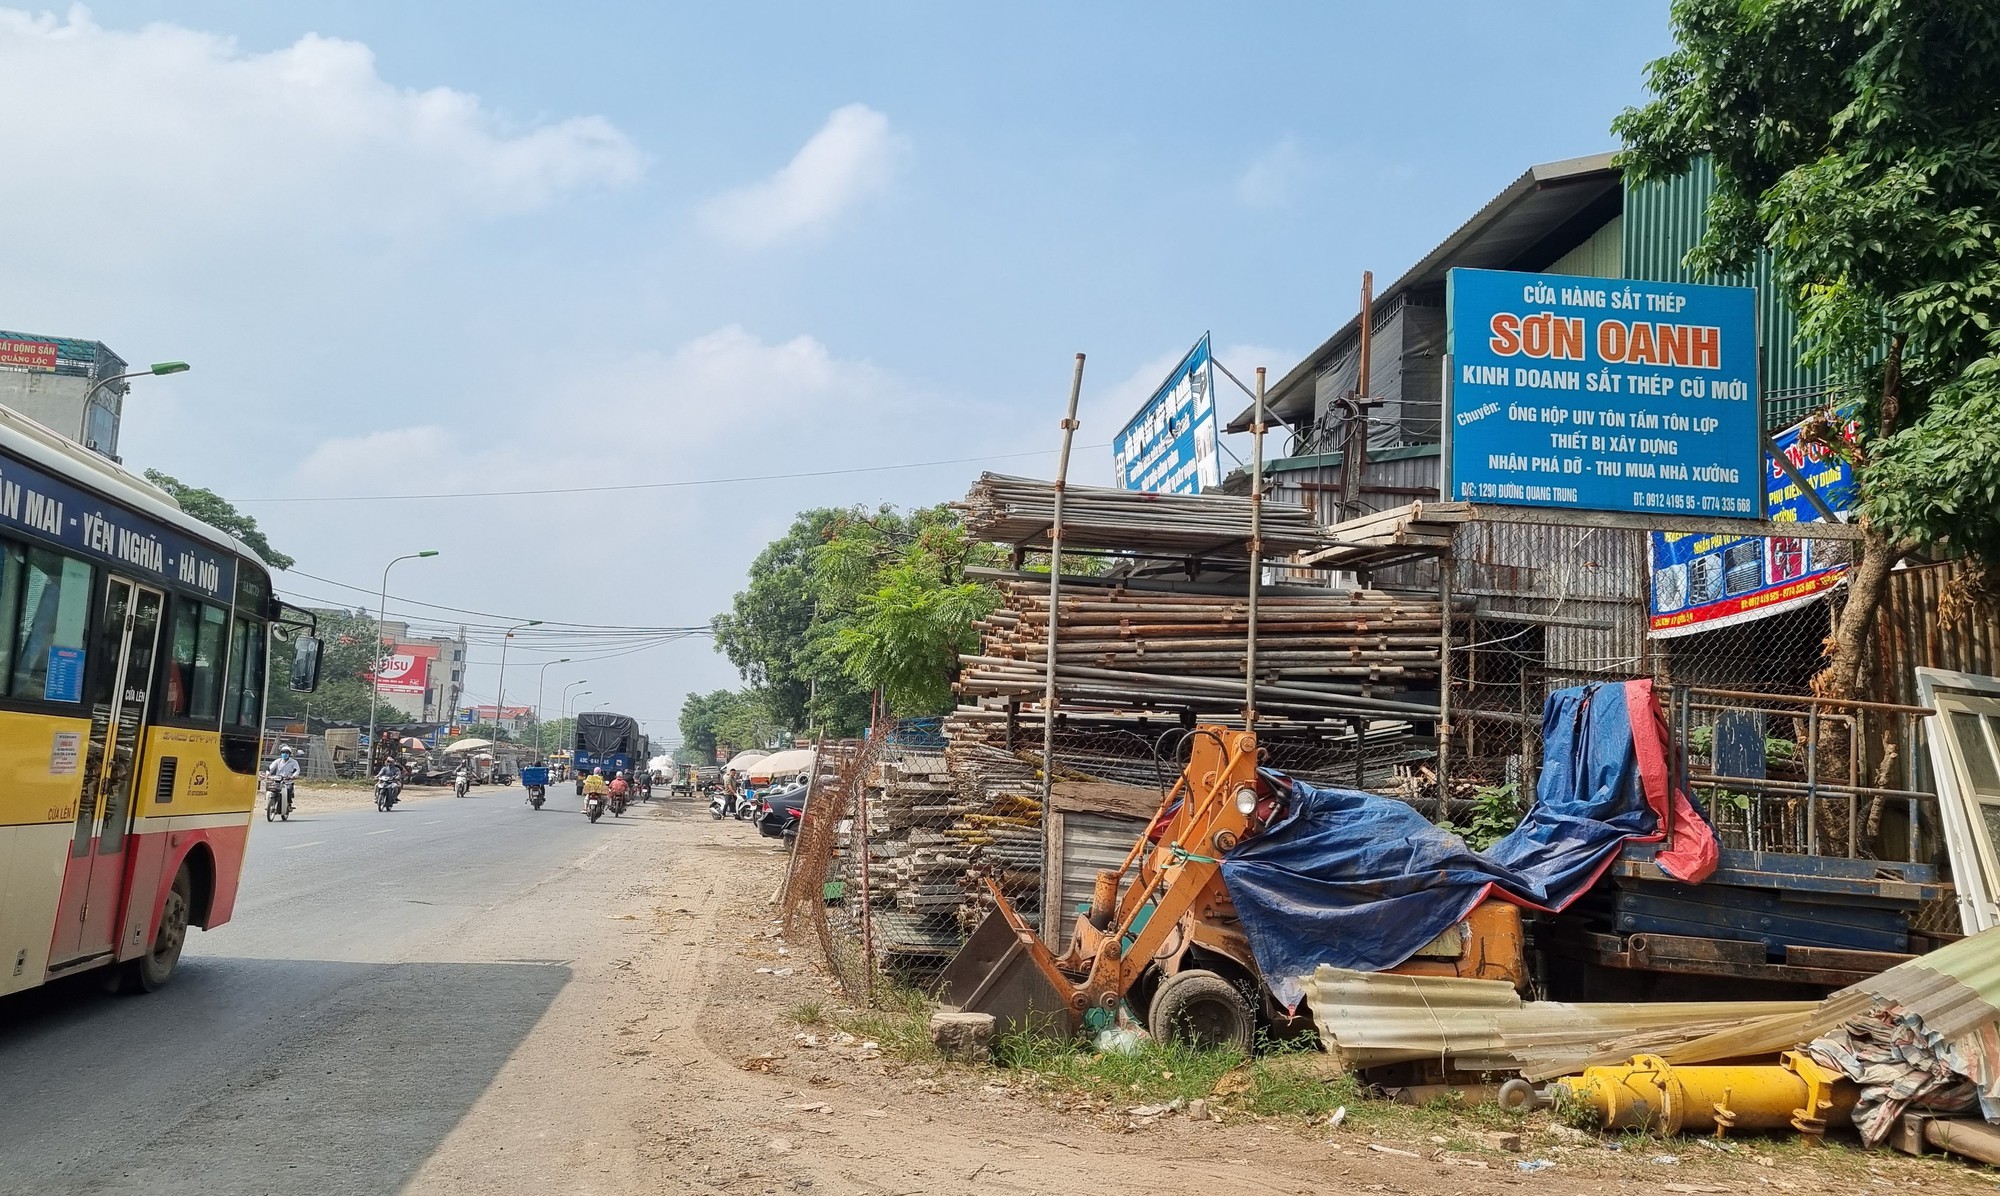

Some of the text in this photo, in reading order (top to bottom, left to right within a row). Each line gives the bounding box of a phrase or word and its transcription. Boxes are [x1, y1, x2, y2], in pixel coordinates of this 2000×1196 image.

[1523, 280, 1687, 313] CỬA HÀNG SẮT THÉP
[1489, 311, 1721, 370] SƠN OANH
[1462, 364, 1748, 401] KINH DOANH SẮT THÉP CŨ MỚI
[1456, 401, 1501, 427] Chuyên:
[1508, 400, 1719, 435] ỐNG HỘP UIV TÔN TẤM TÔN LỢP
[1550, 430, 1678, 457] THIẾT BỊ XÂY DỰNG
[1488, 452, 1528, 474] NHẬN
[1531, 455, 1560, 473] PHÁ
[1563, 456, 1583, 475] DỠ
[1595, 460, 1621, 477] THU
[1625, 462, 1656, 479] MUA
[1660, 462, 1689, 481] NHÀ
[1692, 462, 1739, 484] XƯỞNG
[1498, 481, 1524, 500] ĐƯỜNG
[1525, 485, 1551, 501] QUANG
[1552, 487, 1578, 503] TRUNG
[1633, 491, 1645, 507] ĐT:
[1646, 493, 1665, 507] 0912
[1666, 494, 1685, 509] 4195
[1685, 495, 1695, 509] 95
[1702, 496, 1720, 511] 0774
[1721, 497, 1736, 511] 335
[24, 489, 63, 536] MAI
[83, 511, 115, 555] YÊN
[118, 527, 163, 573] NGHĨA
[179, 550, 196, 585] HÀ
[198, 558, 219, 596] NỘI
[125, 685, 146, 703] CỬA LÊN
[60, 805, 71, 820] LÊN
